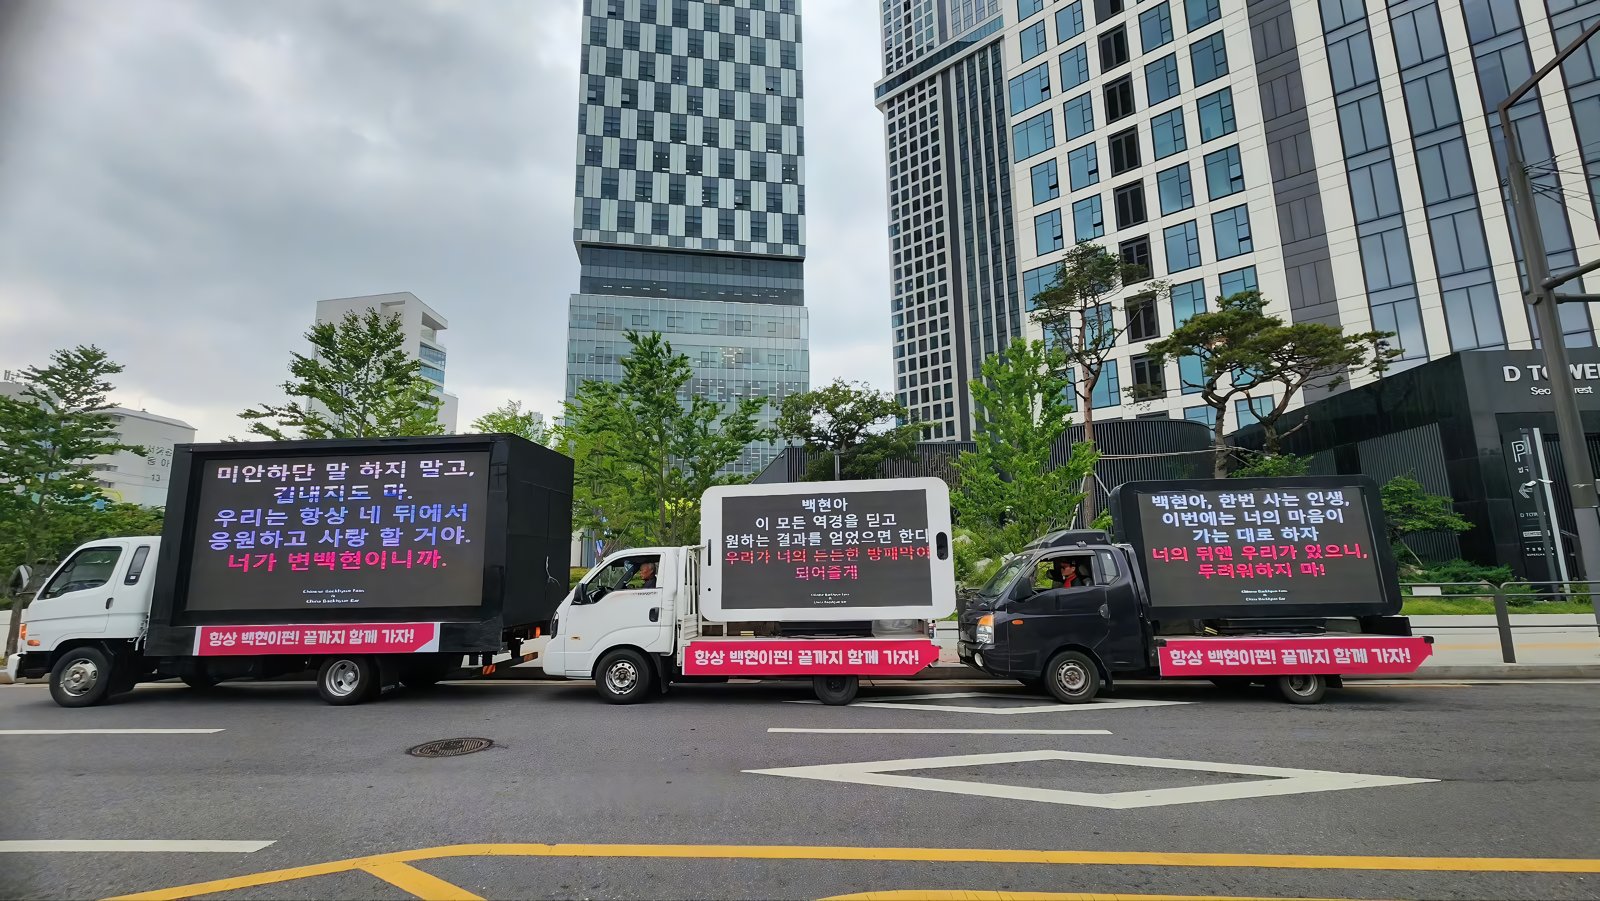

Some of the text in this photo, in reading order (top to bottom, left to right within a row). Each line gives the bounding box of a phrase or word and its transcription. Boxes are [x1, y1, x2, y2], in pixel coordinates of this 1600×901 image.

[1503, 363, 1600, 382] D TWE
[218, 460, 474, 483] 미안하단 말 하지 말고,
[384, 483, 412, 500] 마.
[1152, 491, 1349, 510] 백현아, 한번 사는 인생,
[802, 498, 848, 513] 백현아
[214, 503, 467, 527] 우리는 항상 네 뒤에서
[756, 513, 897, 530] 이 모든 역경을 딛고
[1162, 508, 1343, 527] 이번에는 너의 마음이
[209, 526, 470, 550] 응원하고 사랑 할 거야.
[725, 534, 769, 548] 원하는
[777, 532, 822, 546] 결과를
[829, 530, 891, 545] 얻었으면
[1193, 526, 1319, 543] 가는 대로 하자
[228, 549, 446, 572] 너가 변백현이니까.
[725, 545, 931, 564] 우리가 너의 든든한 방패막이
[1152, 543, 1367, 562] 너의 뒤엔 우리가 있으니,
[1198, 562, 1325, 579] 두려워하지 마!
[210, 629, 414, 646] 항상 백현이편! 끝까지 함께 가자!
[695, 649, 918, 665] 항상 백현이편! 끝까지 함께 가자!
[1170, 648, 1410, 665] 항상 백현이편! 끝까지 함께 가자!
